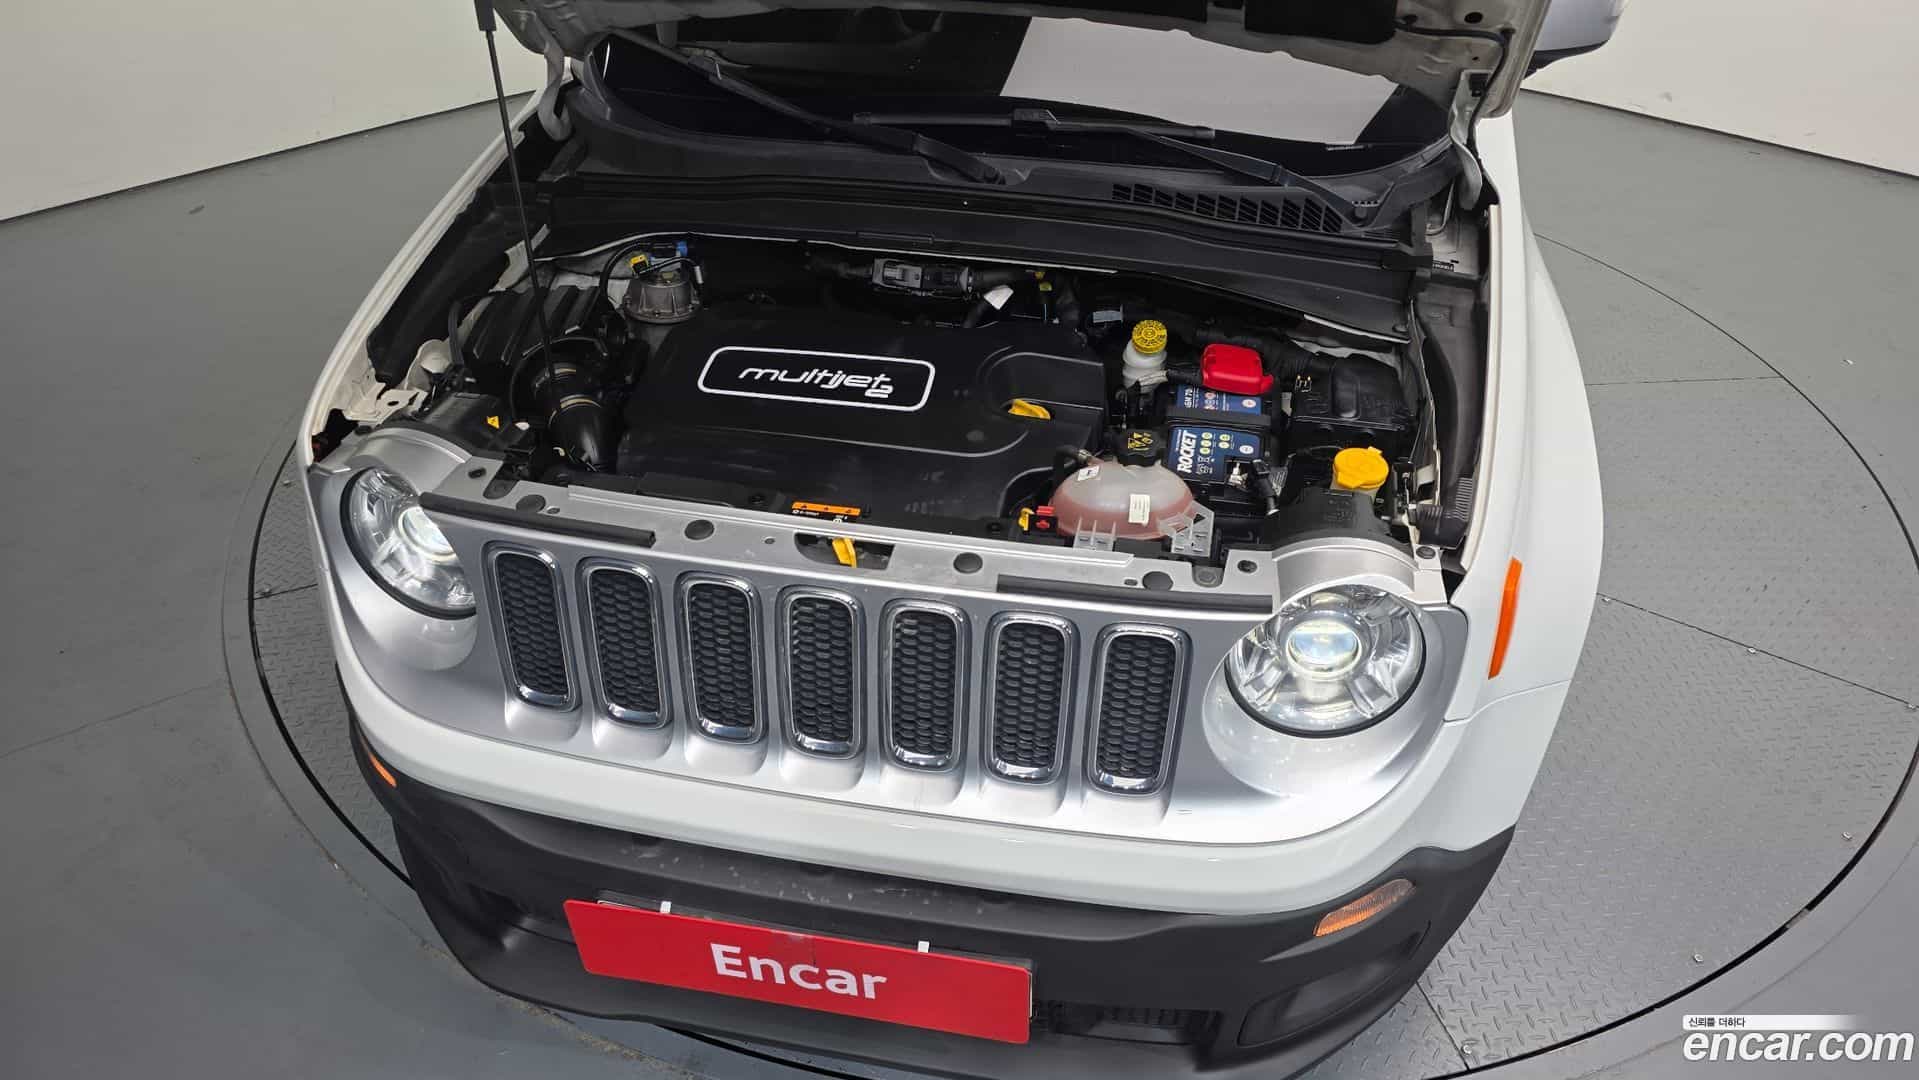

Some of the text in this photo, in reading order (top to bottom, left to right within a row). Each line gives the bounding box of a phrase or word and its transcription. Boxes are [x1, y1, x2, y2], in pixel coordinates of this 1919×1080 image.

[738, 368, 892, 389] multijet
[864, 384, 894, 399] 2
[1177, 429, 1198, 474] ROCKET
[710, 943, 888, 1000] Encar
